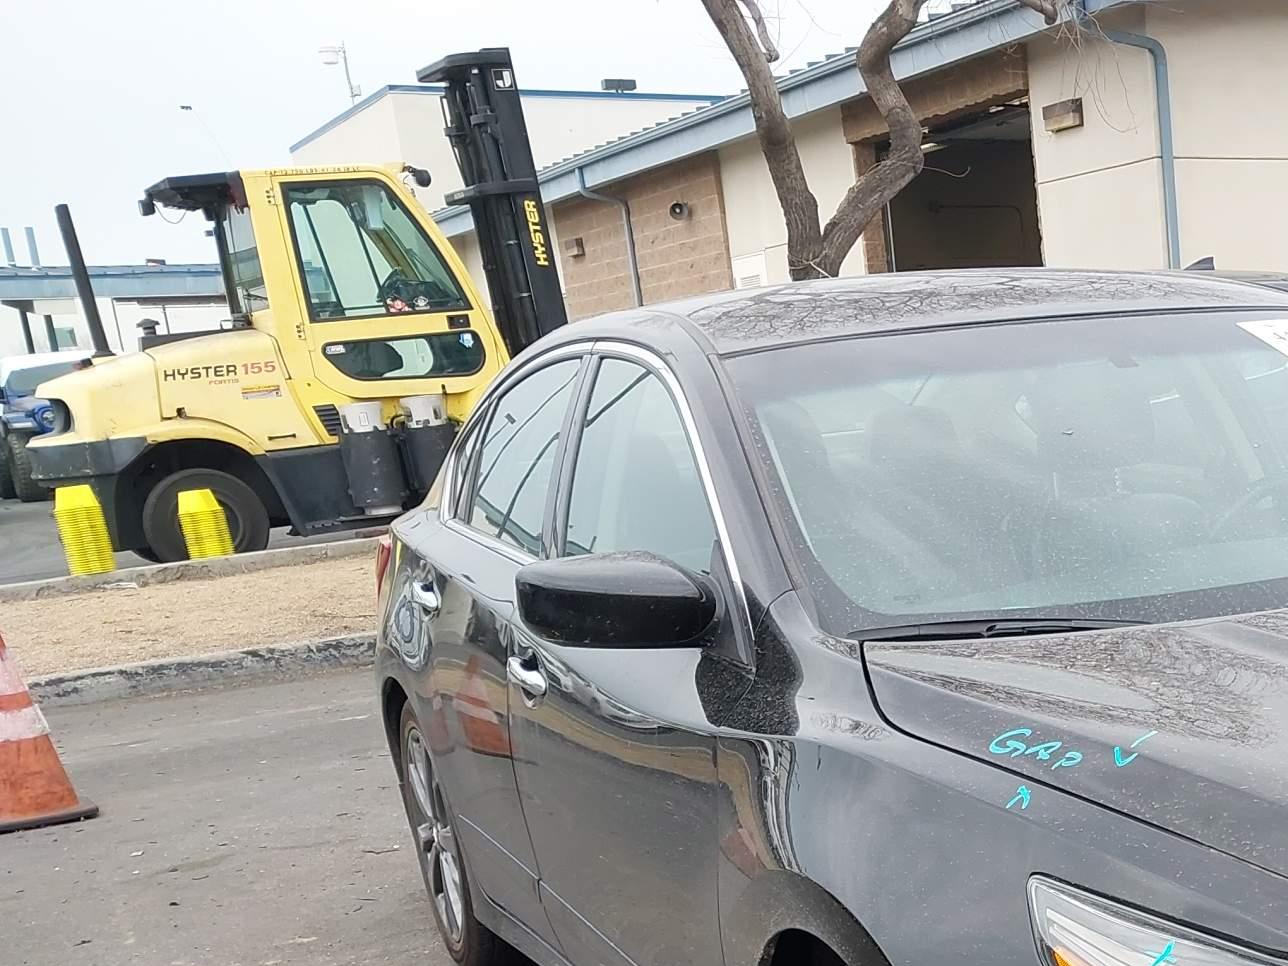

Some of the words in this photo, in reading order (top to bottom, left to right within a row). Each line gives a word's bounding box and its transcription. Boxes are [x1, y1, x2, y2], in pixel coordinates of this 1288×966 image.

[522, 199, 549, 267] HYSTER
[163, 363, 238, 382] HYSTER
[241, 360, 277, 376] 155
